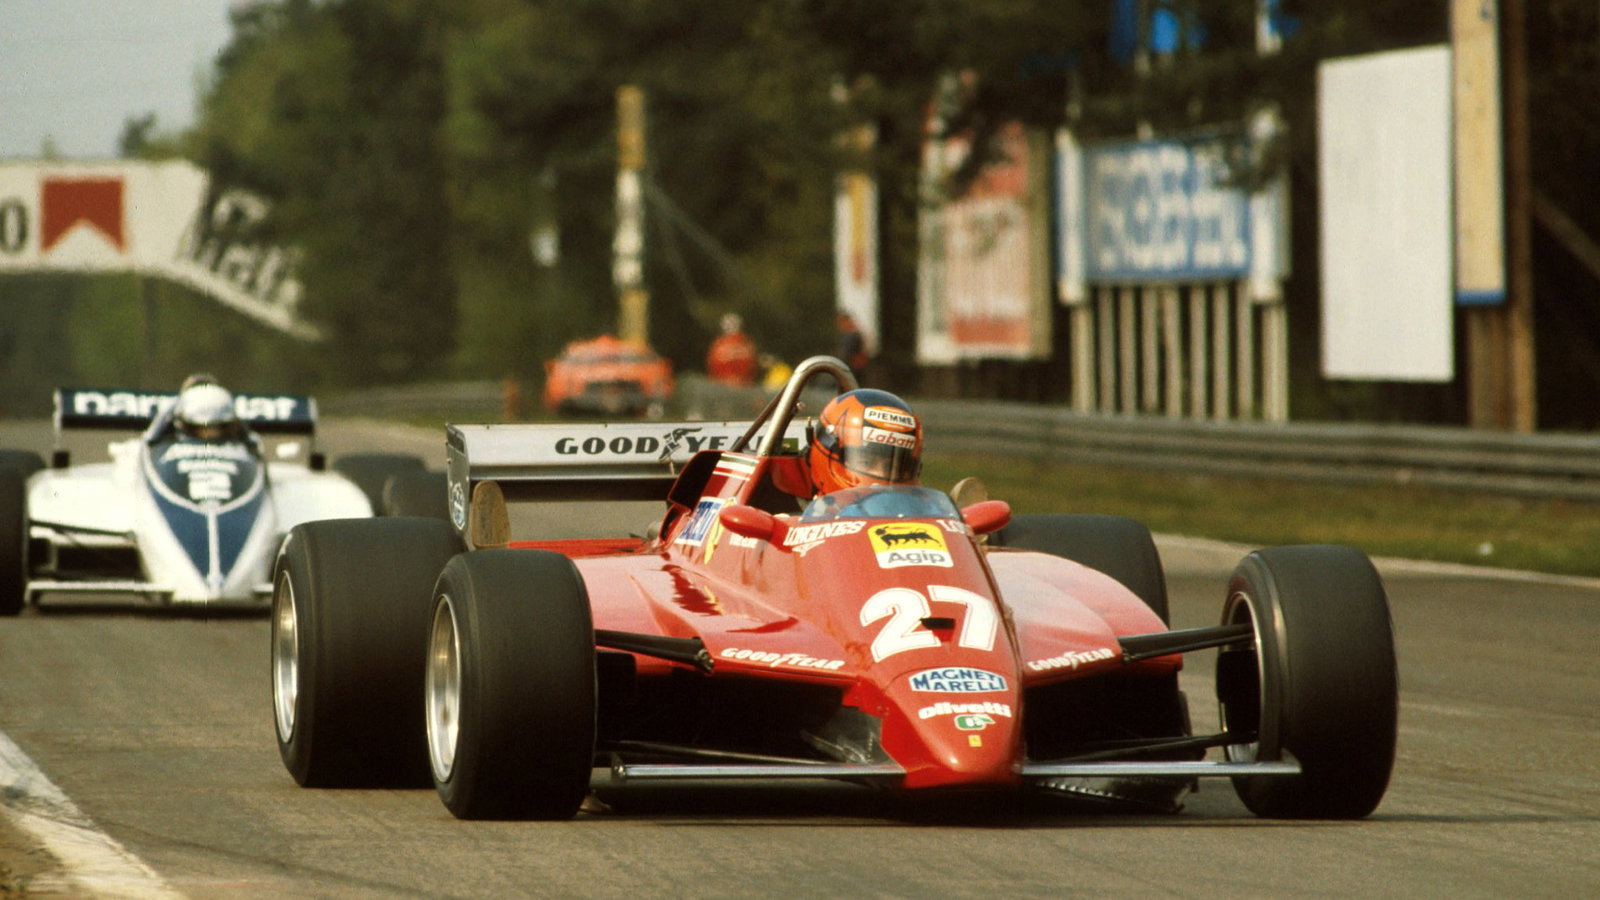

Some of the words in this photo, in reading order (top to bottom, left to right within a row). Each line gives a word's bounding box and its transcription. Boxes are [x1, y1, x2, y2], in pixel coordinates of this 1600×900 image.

[868, 410, 914, 426] PIEMME
[555, 436, 659, 455] GOOD
[686, 435, 764, 454] YEA
[782, 520, 867, 547] LONGINES
[887, 549, 946, 565] Agip
[859, 584, 999, 664] 27
[912, 669, 1005, 685] MAGNETI
[912, 676, 1005, 691] MARELLI
[918, 701, 1013, 720] olivetti
